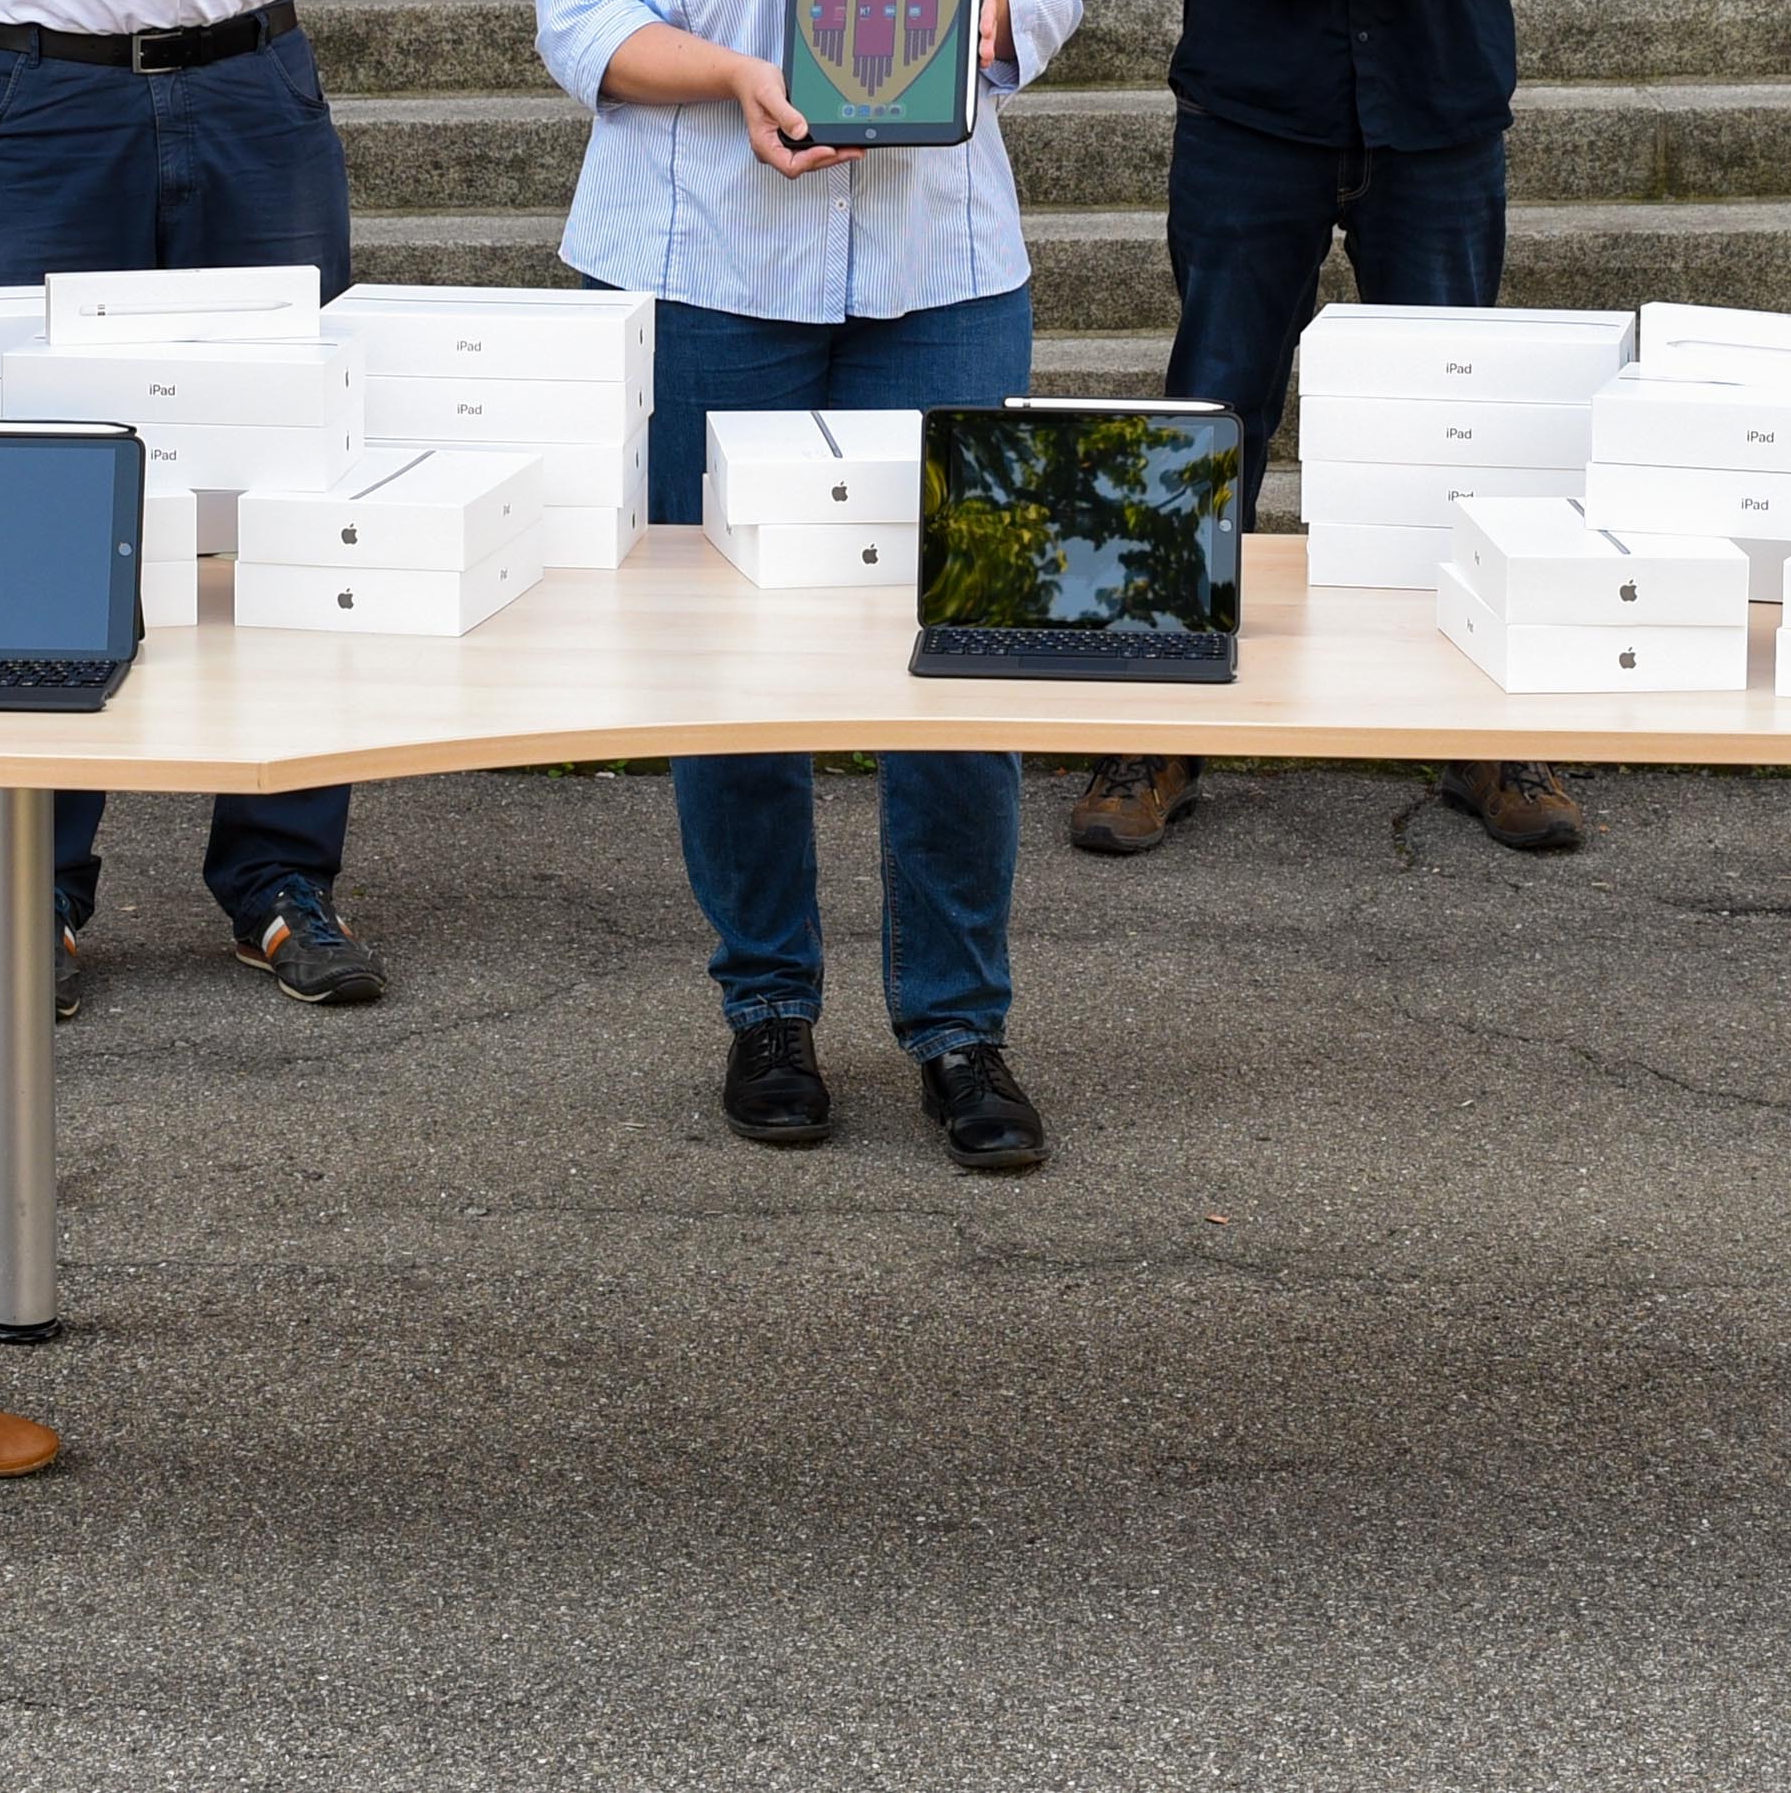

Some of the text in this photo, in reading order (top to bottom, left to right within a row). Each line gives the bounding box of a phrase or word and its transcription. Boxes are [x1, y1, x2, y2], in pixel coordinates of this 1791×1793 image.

[456, 340, 482, 352] iPad
[1445, 362, 1473, 375] iPad
[149, 384, 176, 397] iPad
[456, 403, 483, 415] iPad
[1445, 427, 1473, 440] iPad
[1746, 429, 1775, 444] iPad
[150, 448, 177, 462] iPad
[1741, 497, 1769, 511] iPad
